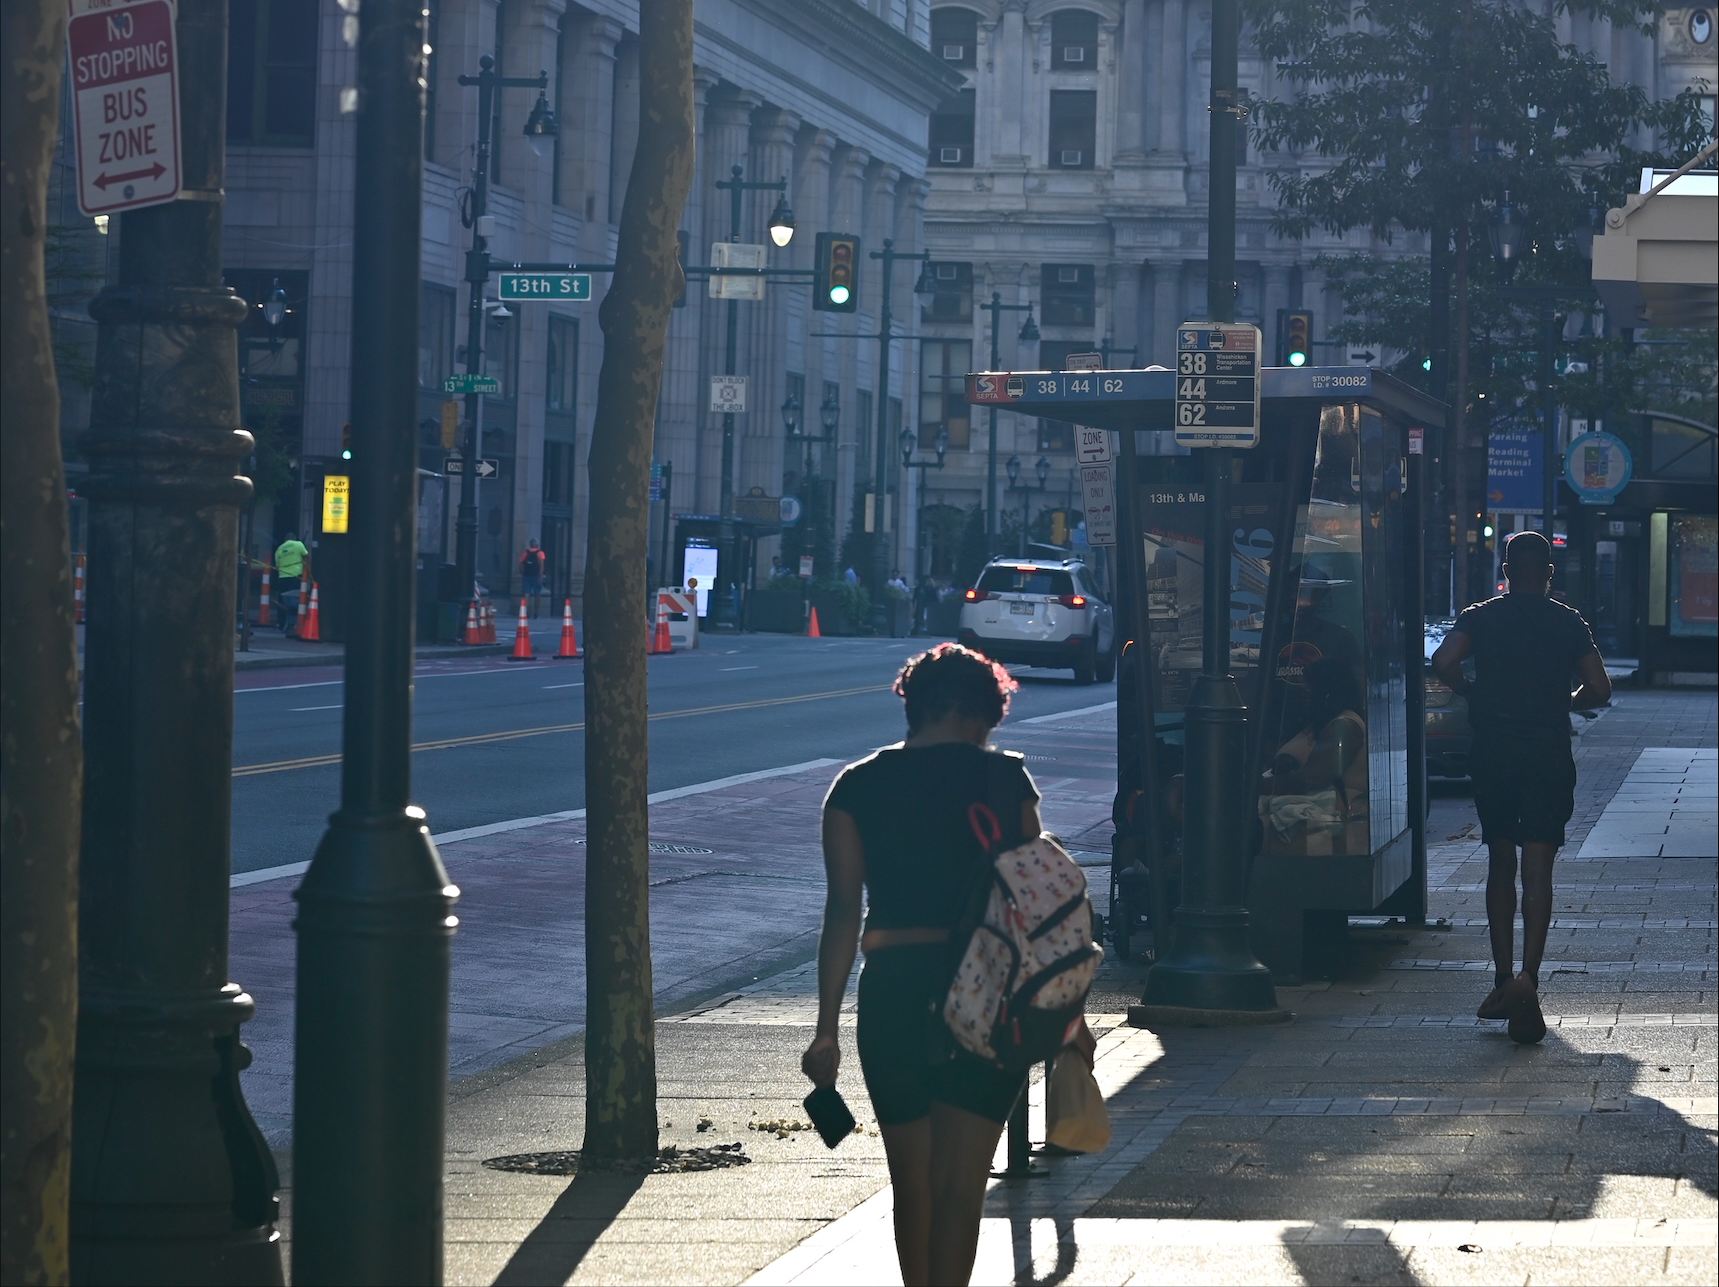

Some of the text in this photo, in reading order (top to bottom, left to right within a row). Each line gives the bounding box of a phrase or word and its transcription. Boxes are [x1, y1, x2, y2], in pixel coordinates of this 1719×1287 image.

[106, 12, 133, 42] NO
[76, 40, 169, 83] STOPPING
[103, 87, 147, 124] BUS
[98, 124, 157, 164] ZONE
[510, 279, 580, 294] 13th St
[1181, 353, 1207, 374] 38
[1038, 379, 1123, 394] 38 44 62
[1332, 375, 1367, 387] 30082
[474, 384, 497, 392] STREET
[1180, 378, 1206, 400] 44
[713, 403, 744, 411] THE BOX
[1179, 404, 1206, 425] 62
[1083, 431, 1103, 445] ZONE
[1488, 433, 1528, 443] Parking
[1488, 448, 1529, 458] Reading
[1488, 458, 1531, 467] Terminal
[1084, 471, 1107, 482] LOADING
[1488, 468, 1524, 476] Market
[1090, 487, 1104, 498] ONLY
[1150, 492, 1205, 503] 13th & Ma
